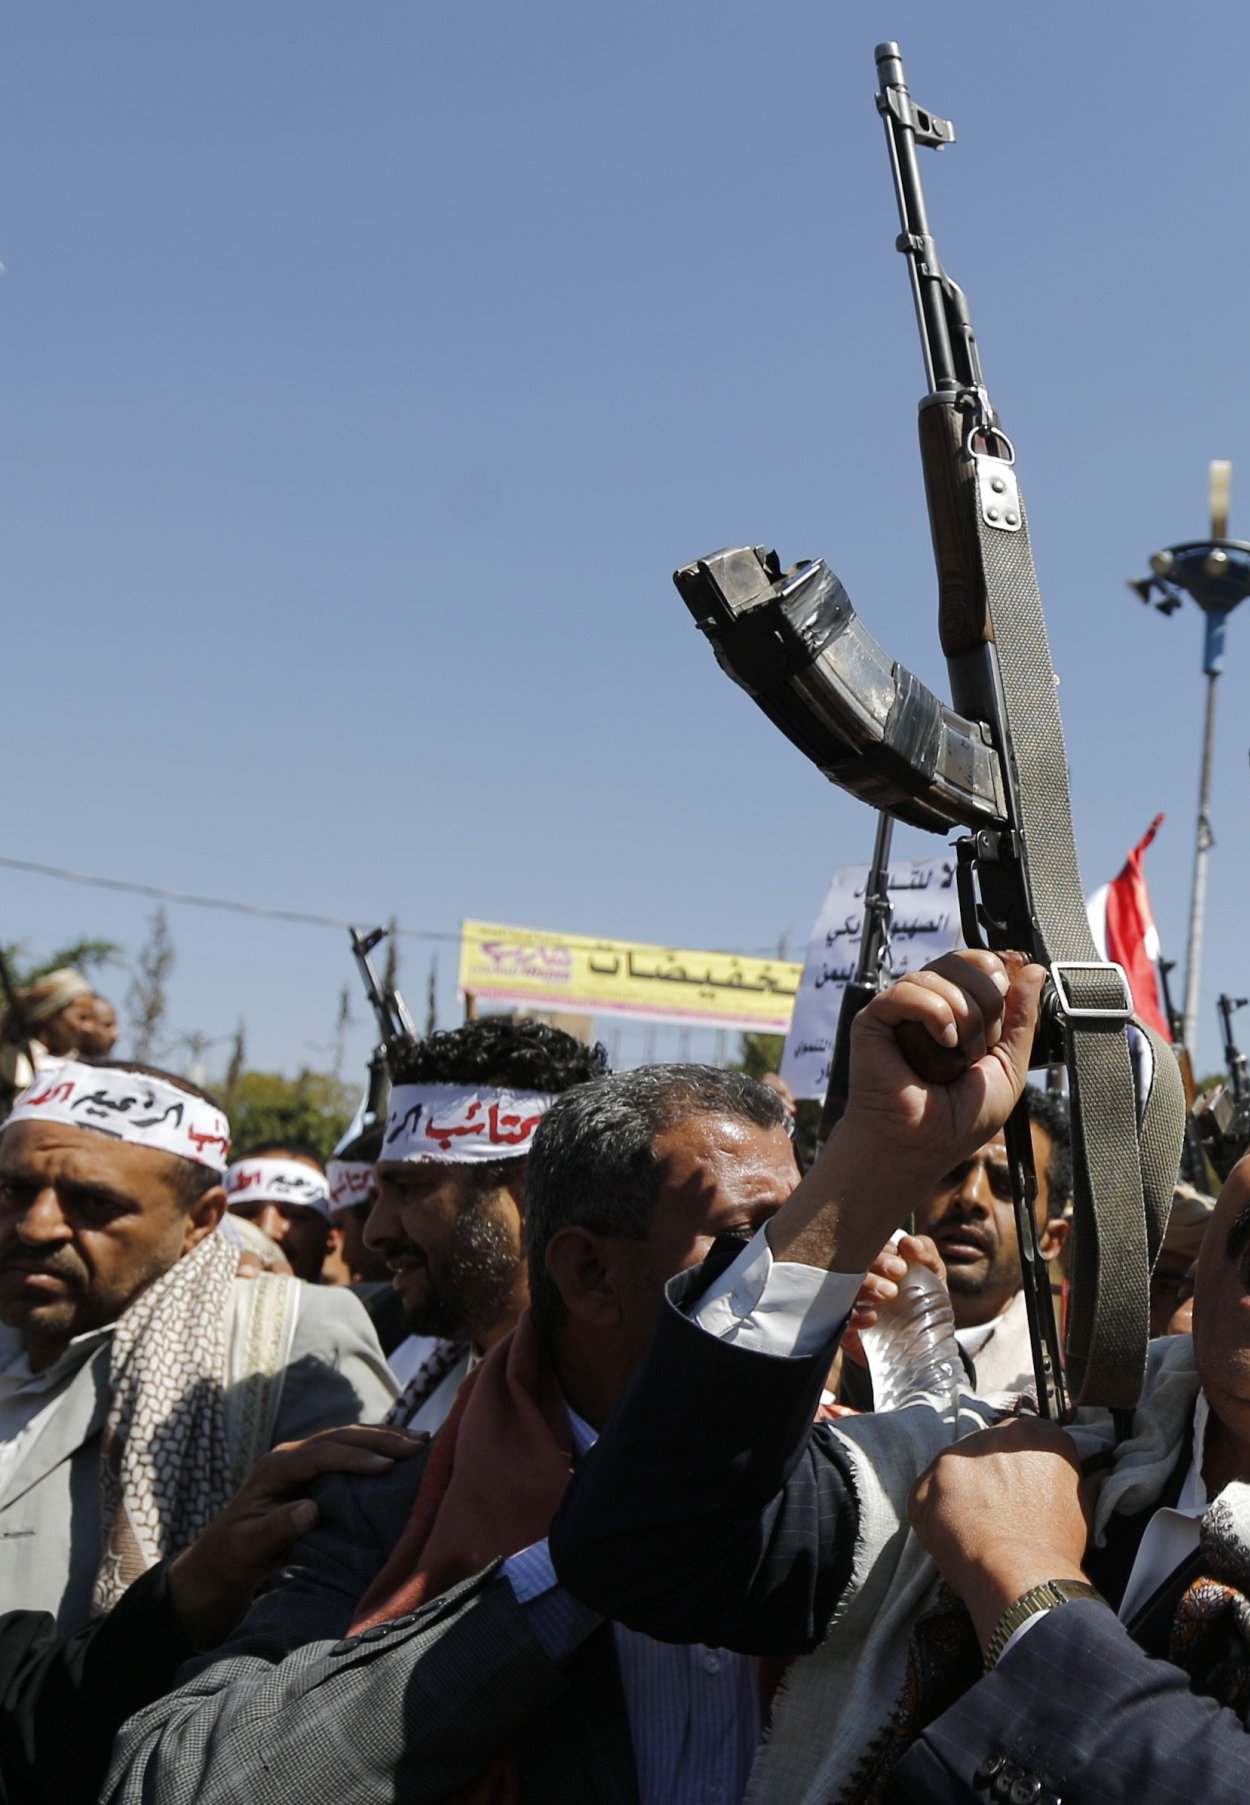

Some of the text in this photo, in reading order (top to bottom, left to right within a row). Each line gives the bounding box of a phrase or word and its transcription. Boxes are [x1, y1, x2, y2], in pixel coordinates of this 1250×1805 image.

[940, 862, 956, 888] لا
[814, 961, 855, 989] ليمن
[425, 1101, 541, 1150] كتائب
